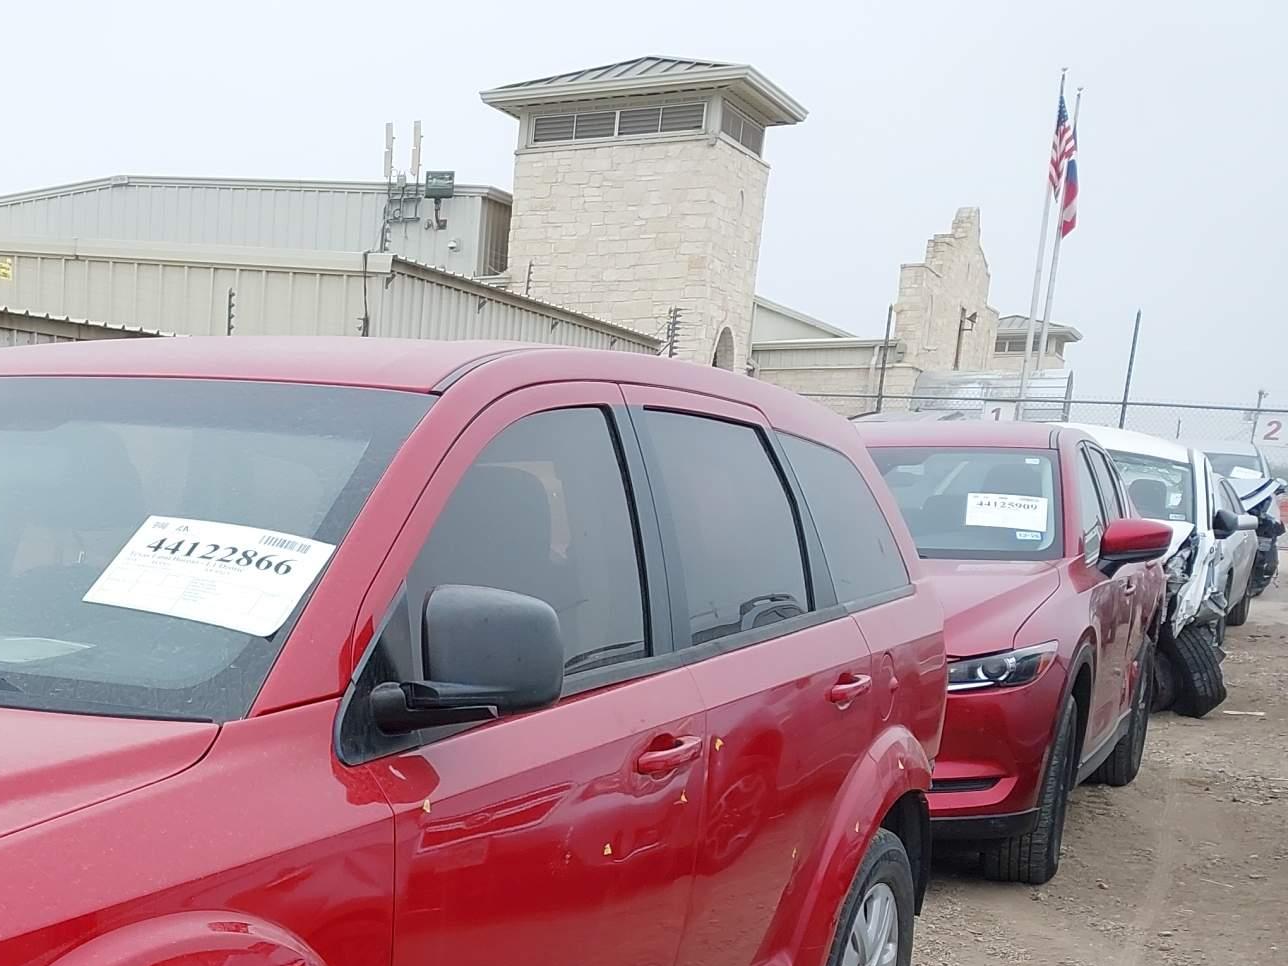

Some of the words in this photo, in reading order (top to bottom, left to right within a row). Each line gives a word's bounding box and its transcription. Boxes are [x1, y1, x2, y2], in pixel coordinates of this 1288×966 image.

[991, 407, 1001, 421] 1
[1263, 420, 1283, 441] 2
[145, 537, 298, 576] 44122866
